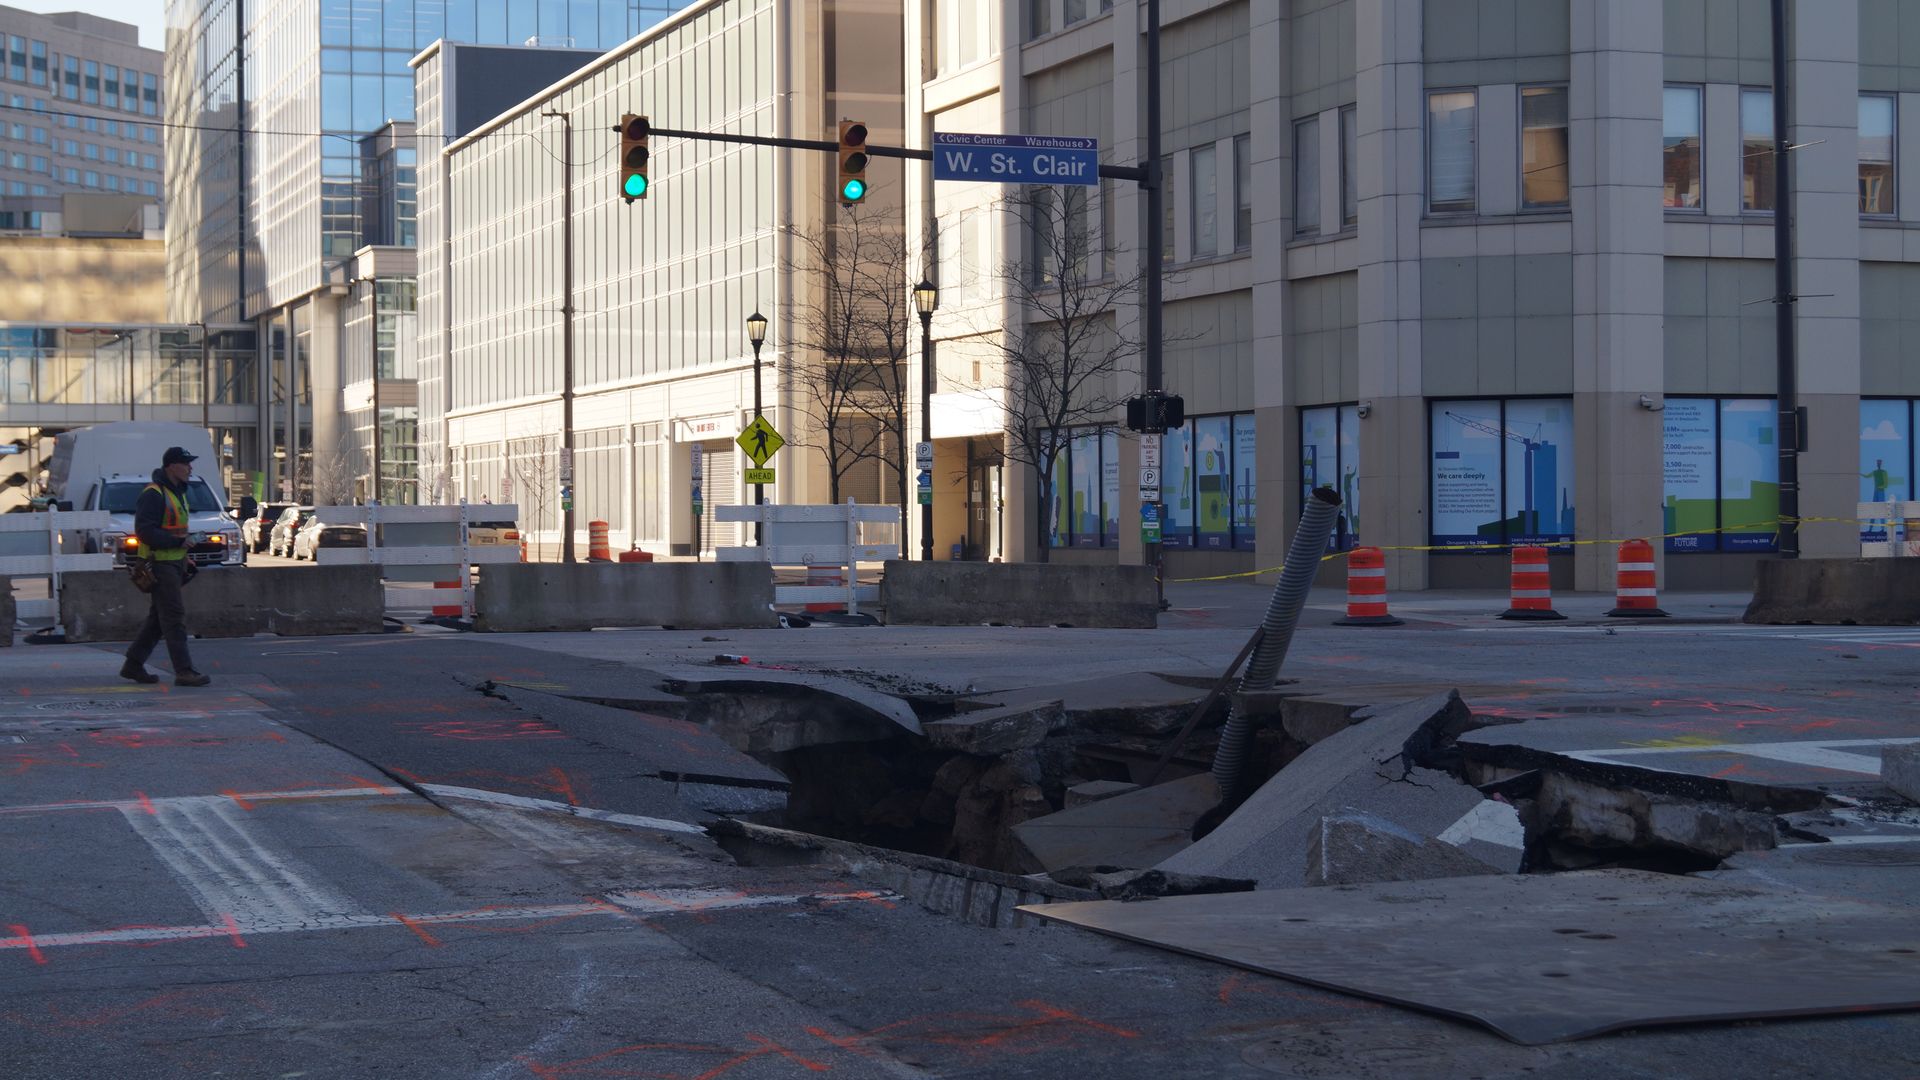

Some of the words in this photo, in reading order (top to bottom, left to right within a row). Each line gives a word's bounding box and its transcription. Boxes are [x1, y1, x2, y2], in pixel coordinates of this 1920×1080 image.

[946, 134, 970, 144] Civic
[973, 135, 1007, 145] Center
[1025, 136, 1083, 148] Warehouse
[945, 151, 979, 173] W.
[990, 152, 1022, 174] St.
[1032, 154, 1086, 176] Clair
[921, 446, 928, 454] P
[748, 471, 772, 480] AHEAD
[1146, 473, 1153, 482] P
[1437, 472, 1448, 480] We
[1463, 472, 1486, 480] deeply
